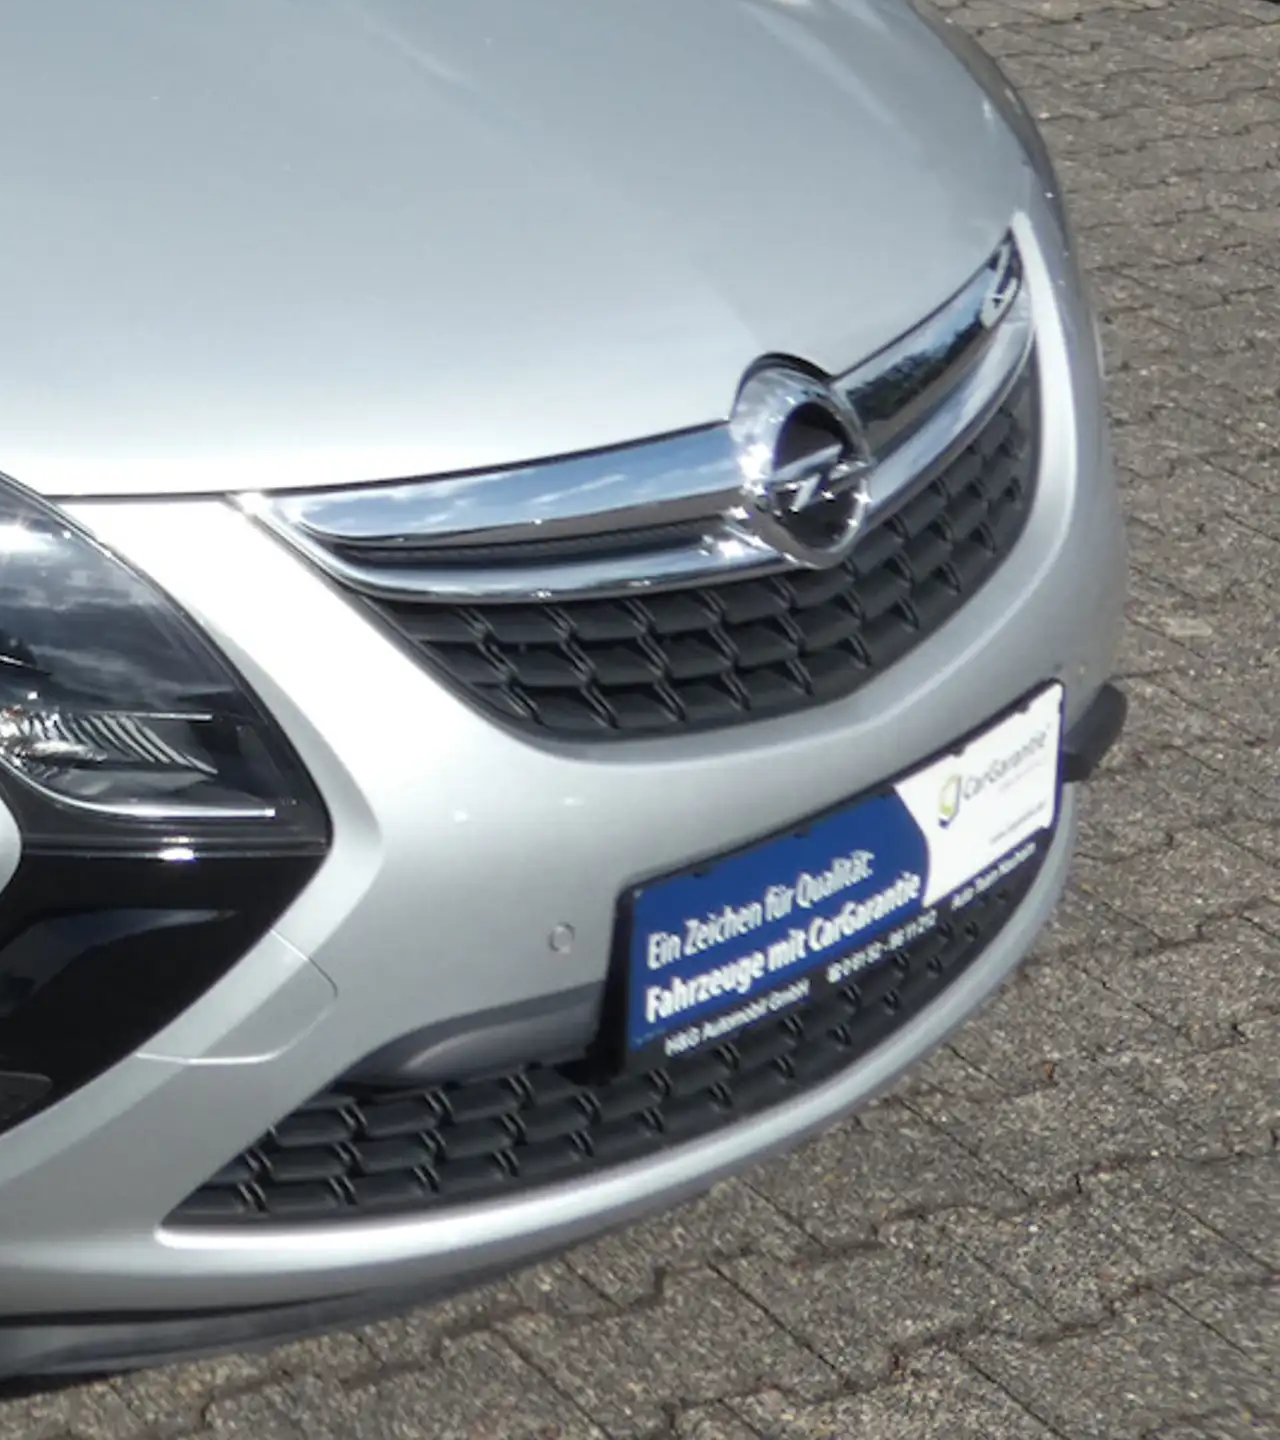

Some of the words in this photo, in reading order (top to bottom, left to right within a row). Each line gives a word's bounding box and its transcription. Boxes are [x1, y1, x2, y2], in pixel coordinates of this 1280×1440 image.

[645, 951, 766, 1023] Fahrzeuge
[767, 928, 807, 971] mit
[808, 871, 921, 951] CarGarantie
[647, 931, 682, 970] Ein
[683, 901, 763, 956] Zeichen
[764, 883, 795, 922] für
